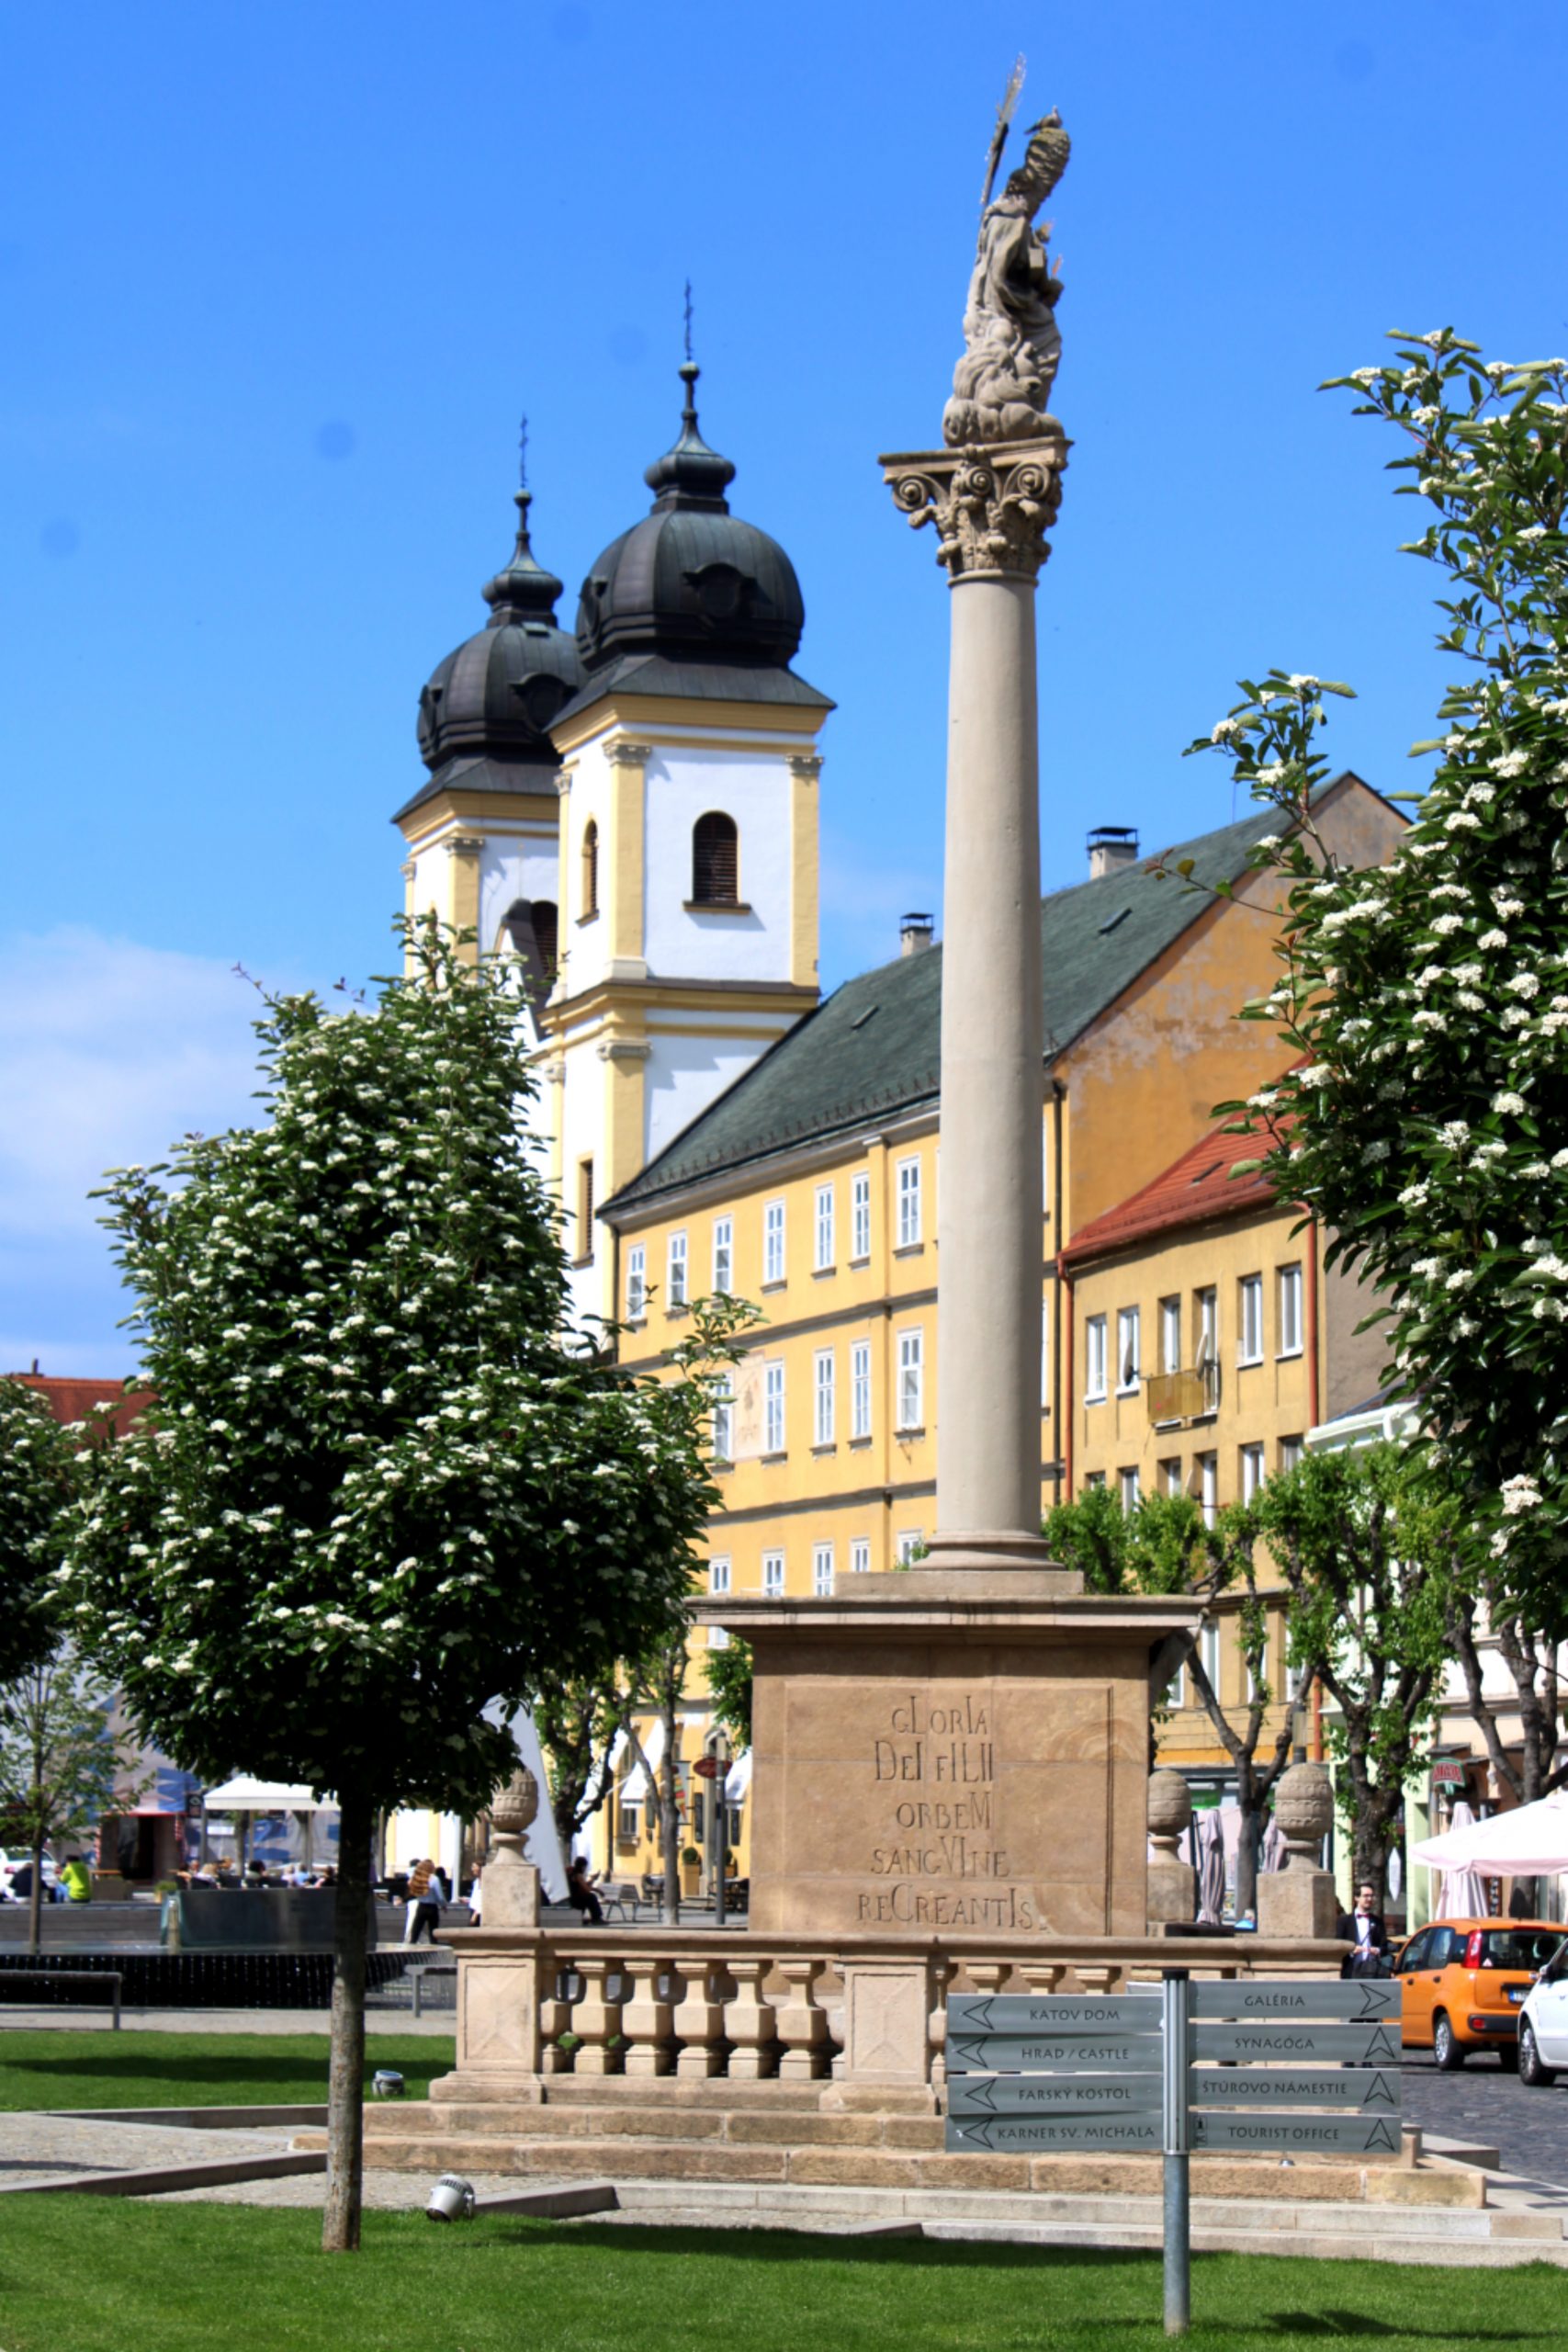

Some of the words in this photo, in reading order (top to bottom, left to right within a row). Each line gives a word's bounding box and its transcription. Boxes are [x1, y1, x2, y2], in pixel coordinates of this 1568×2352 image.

[1245, 1994, 1305, 2007] GALÉRIA
[1030, 2009, 1079, 2020] KATOV
[1085, 2009, 1120, 2020] DOM
[1235, 2037, 1314, 2050] SYNAGÓGA
[1022, 2048, 1063, 2059] HRAD
[1078, 2048, 1129, 2060] CASTLE
[1019, 2087, 1071, 2100] FARSKÝ
[1077, 2088, 1131, 2100] KOSTOL
[1202, 2080, 1270, 2094] ŠTÚROVO
[1274, 2081, 1347, 2094] NÁMESTIE
[998, 2127, 1055, 2139] KARNER
[1061, 2127, 1081, 2139] SV.
[1085, 2126, 1155, 2139] MICHALA
[1227, 2126, 1290, 2139] TOURIST
[1292, 2128, 1339, 2140] OFFICE
